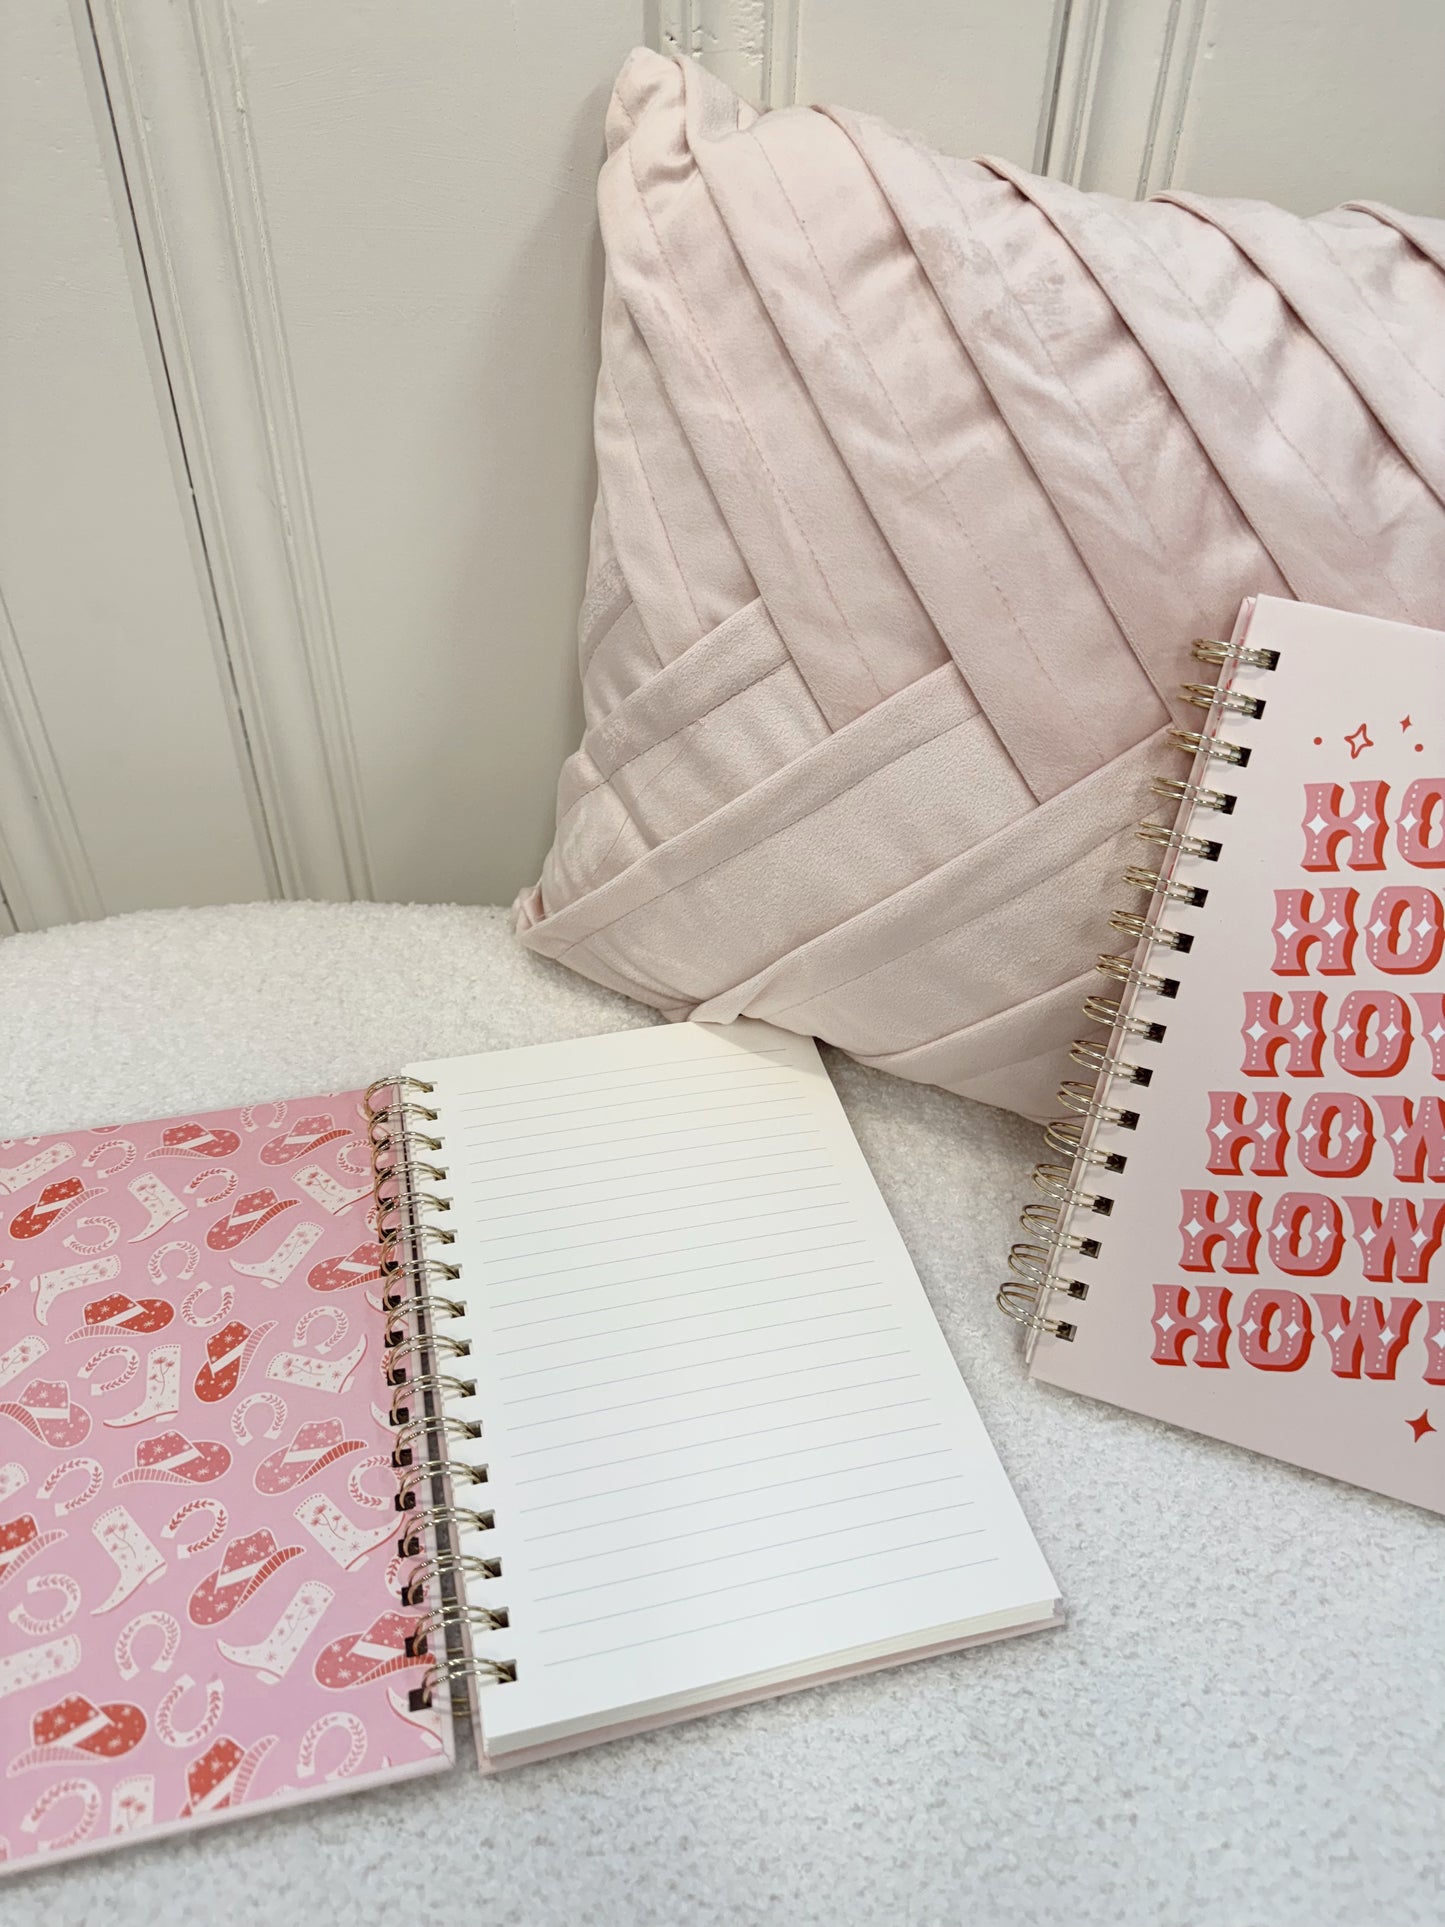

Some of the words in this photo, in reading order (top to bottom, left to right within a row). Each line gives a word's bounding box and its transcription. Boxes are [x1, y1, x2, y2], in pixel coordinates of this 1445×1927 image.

[1270, 886, 1445, 976] HO
[1205, 1091, 1445, 1184] HOW
[1178, 1189, 1445, 1284] HOW
[1150, 1284, 1445, 1386] HOW
